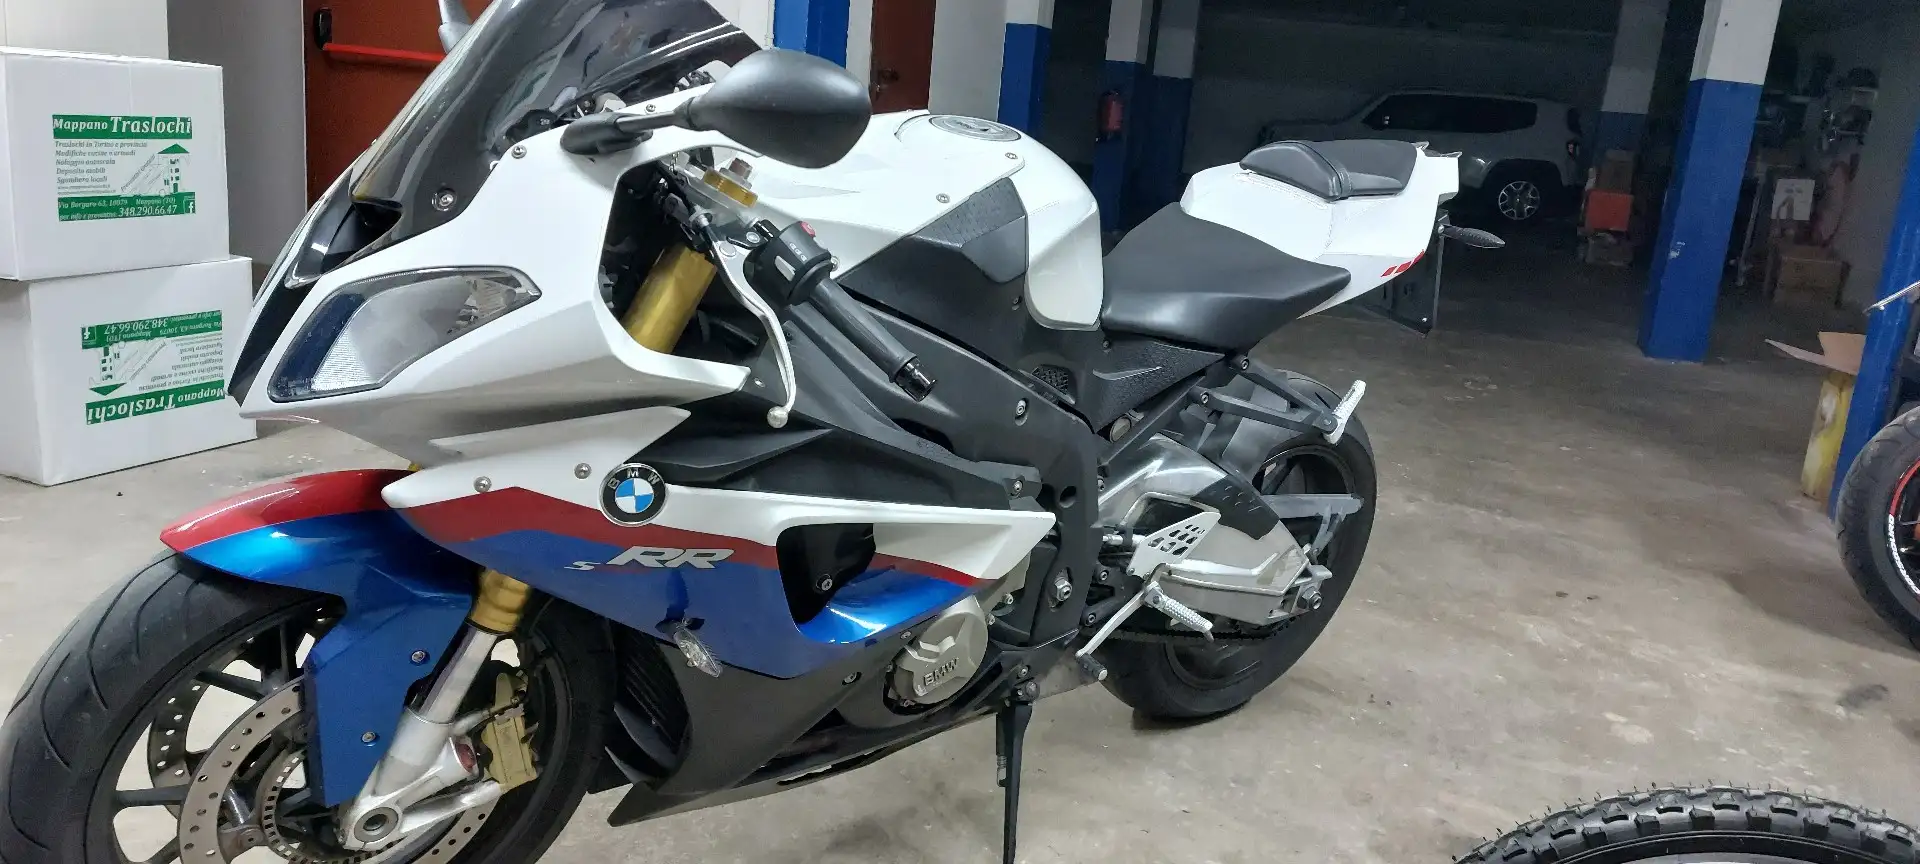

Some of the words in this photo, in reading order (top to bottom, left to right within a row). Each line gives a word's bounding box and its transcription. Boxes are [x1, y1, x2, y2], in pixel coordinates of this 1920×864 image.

[53, 119, 108, 132] Mappano
[110, 116, 191, 133] Traslochi
[71, 202, 97, 210] Borgaro
[118, 205, 177, 217] 348.290.66.47
[104, 317, 168, 334] 348.290.66.47
[106, 334, 121, 342] (TO)
[123, 330, 151, 338] Mappano
[178, 387, 224, 402] Mappano
[87, 394, 176, 425] Traslochi
[564, 561, 601, 571] S
[606, 546, 735, 569] RR
[924, 658, 959, 686] BMW
